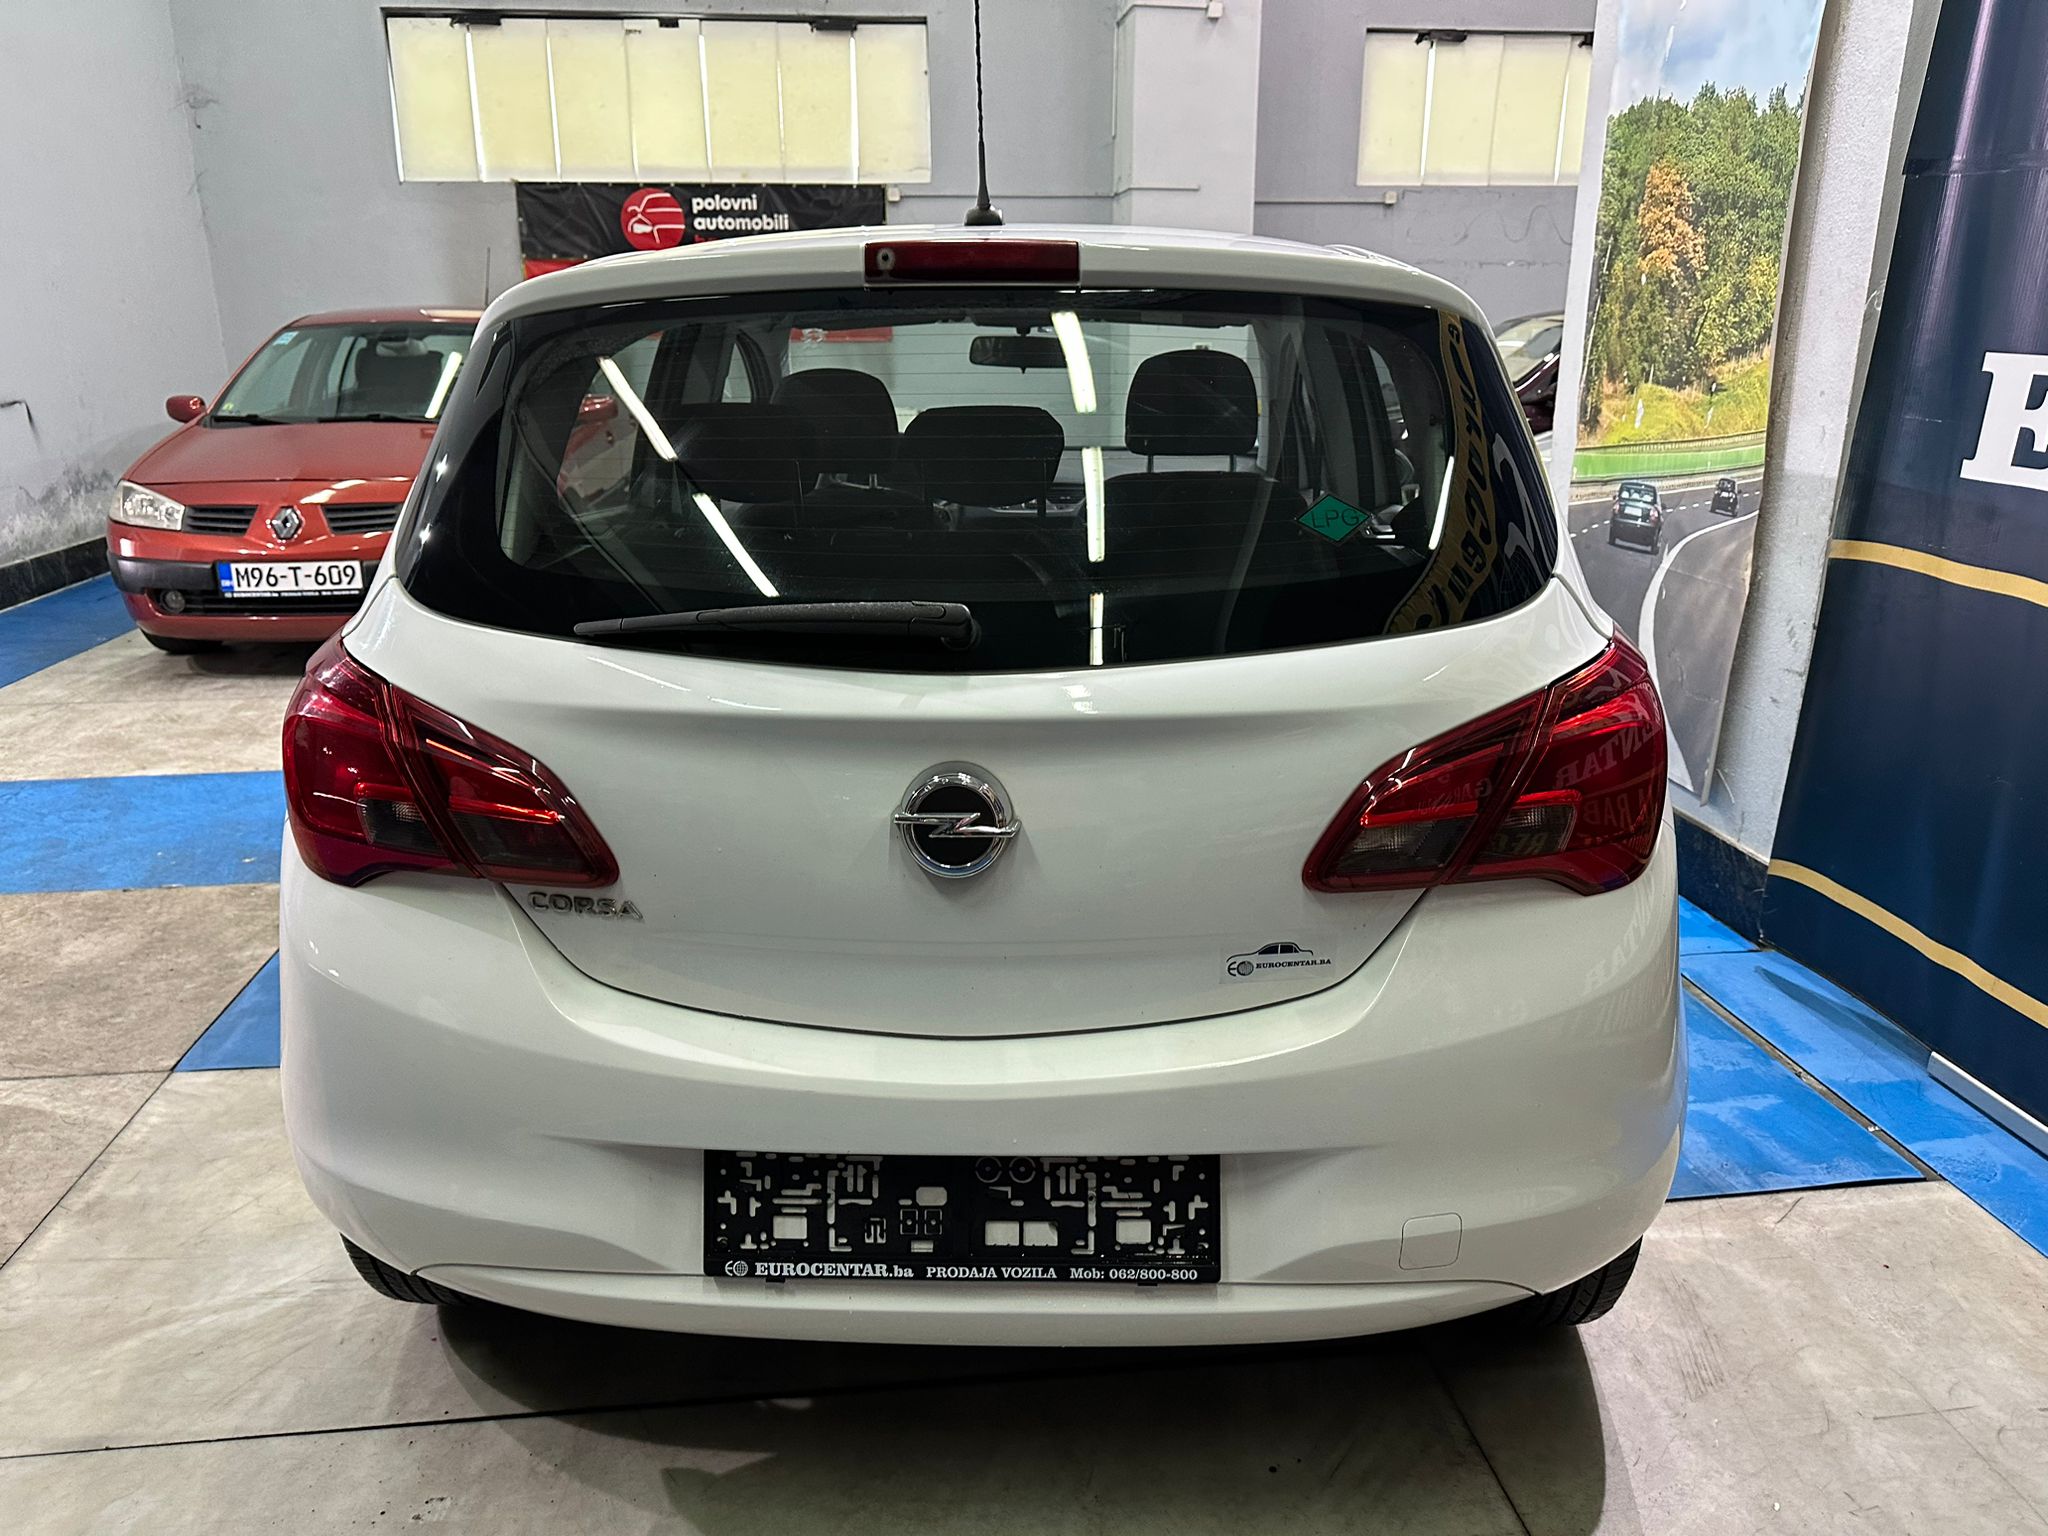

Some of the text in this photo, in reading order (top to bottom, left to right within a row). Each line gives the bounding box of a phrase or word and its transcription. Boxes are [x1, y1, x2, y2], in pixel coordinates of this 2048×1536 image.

[691, 194, 758, 214] polovni
[693, 213, 789, 230] automobili
[1310, 508, 1361, 529] LPG
[234, 565, 356, 588] M96-T-609
[528, 891, 644, 921] CORSA
[1255, 958, 1332, 970] EUROCENTAR.BA
[754, 1261, 1198, 1281] EUROCENTAR.ba PRODAJA VOZILA Mob: 062/800-800
